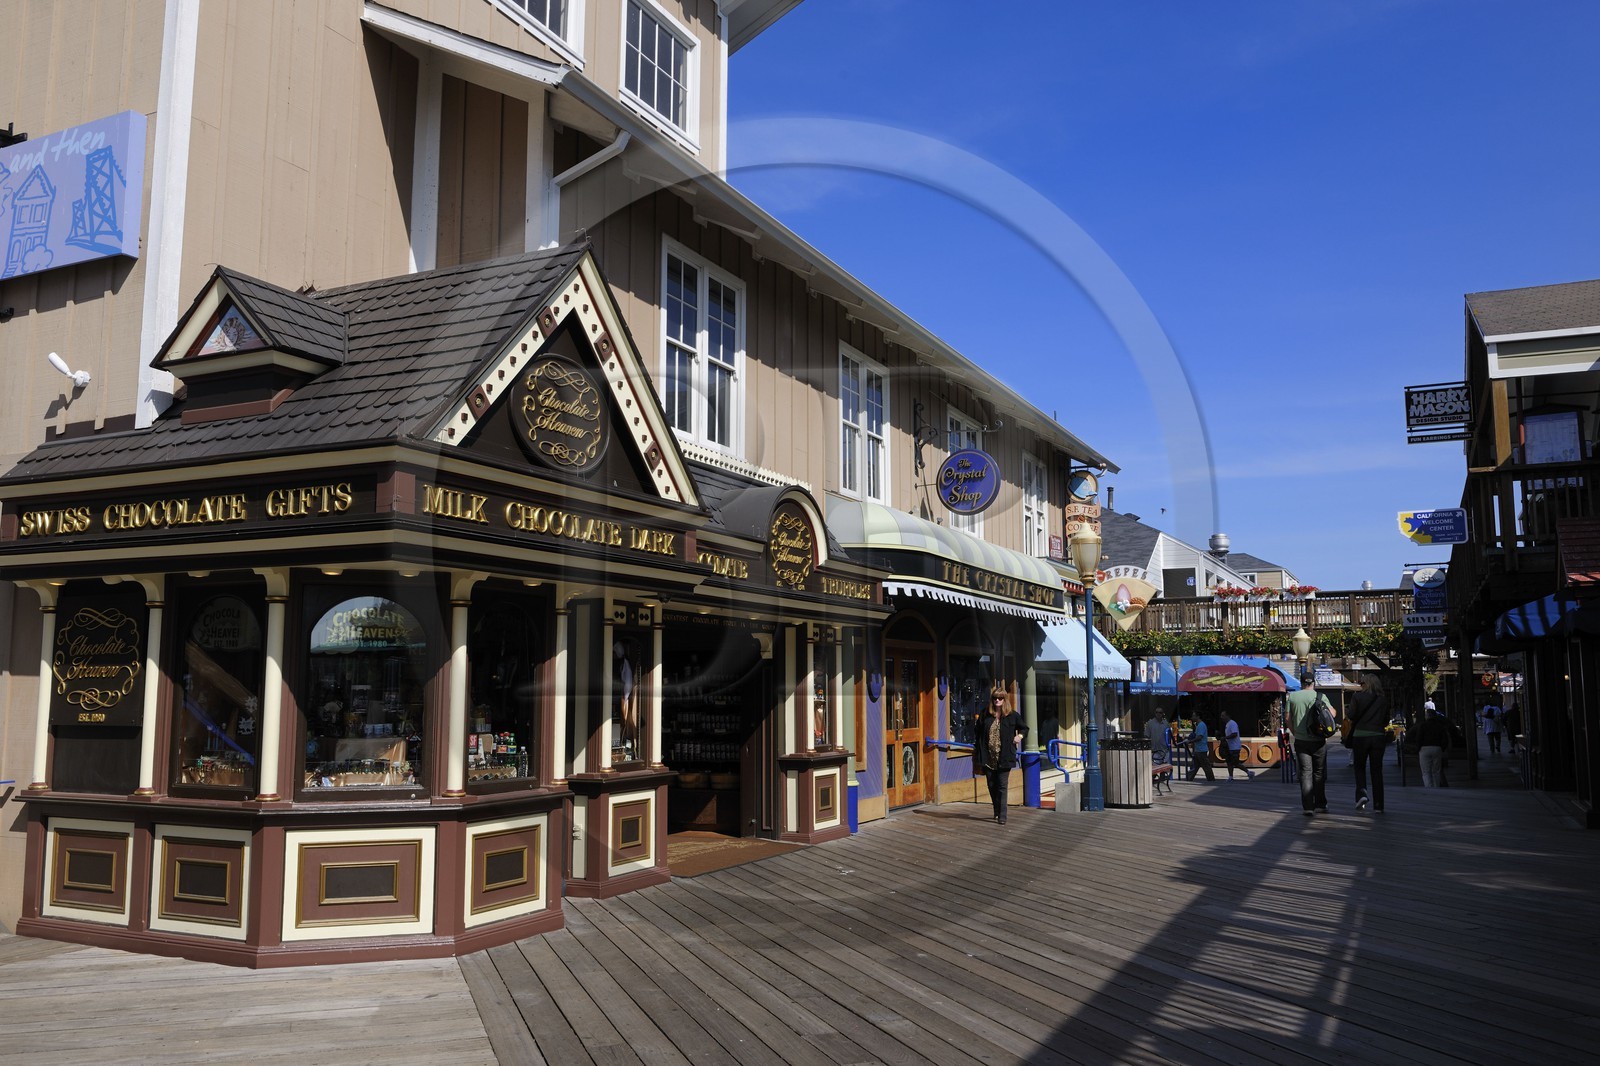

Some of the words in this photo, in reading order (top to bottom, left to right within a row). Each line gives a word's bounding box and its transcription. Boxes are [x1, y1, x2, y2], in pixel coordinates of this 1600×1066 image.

[10, 139, 49, 173] and
[51, 128, 105, 162] then
[538, 387, 590, 418] Chocolate
[1411, 388, 1468, 405] HARRY
[1409, 400, 1470, 417] MASON
[536, 408, 585, 439] Heaven
[942, 463, 989, 486] Crystal
[959, 459, 972, 467] The
[948, 485, 982, 508] Shop
[20, 506, 92, 537] SWISS
[103, 493, 247, 530] CHOCOLATE
[265, 482, 353, 517] GIFTS
[422, 483, 489, 524] MILK
[505, 500, 622, 547] CHOCOLATE
[630, 526, 676, 556] DARK
[1067, 506, 1080, 514] S.F.
[1082, 506, 1098, 516] TEA
[943, 561, 970, 586] THE
[975, 570, 1026, 600] CRYSTAL
[1029, 585, 1055, 606] SHOP
[333, 607, 405, 626] CHOCOLATE
[345, 627, 393, 639] HEAVEN
[369, 640, 388, 648] 1980
[69, 635, 131, 657] Chocolate
[67, 656, 122, 680] Heaven
